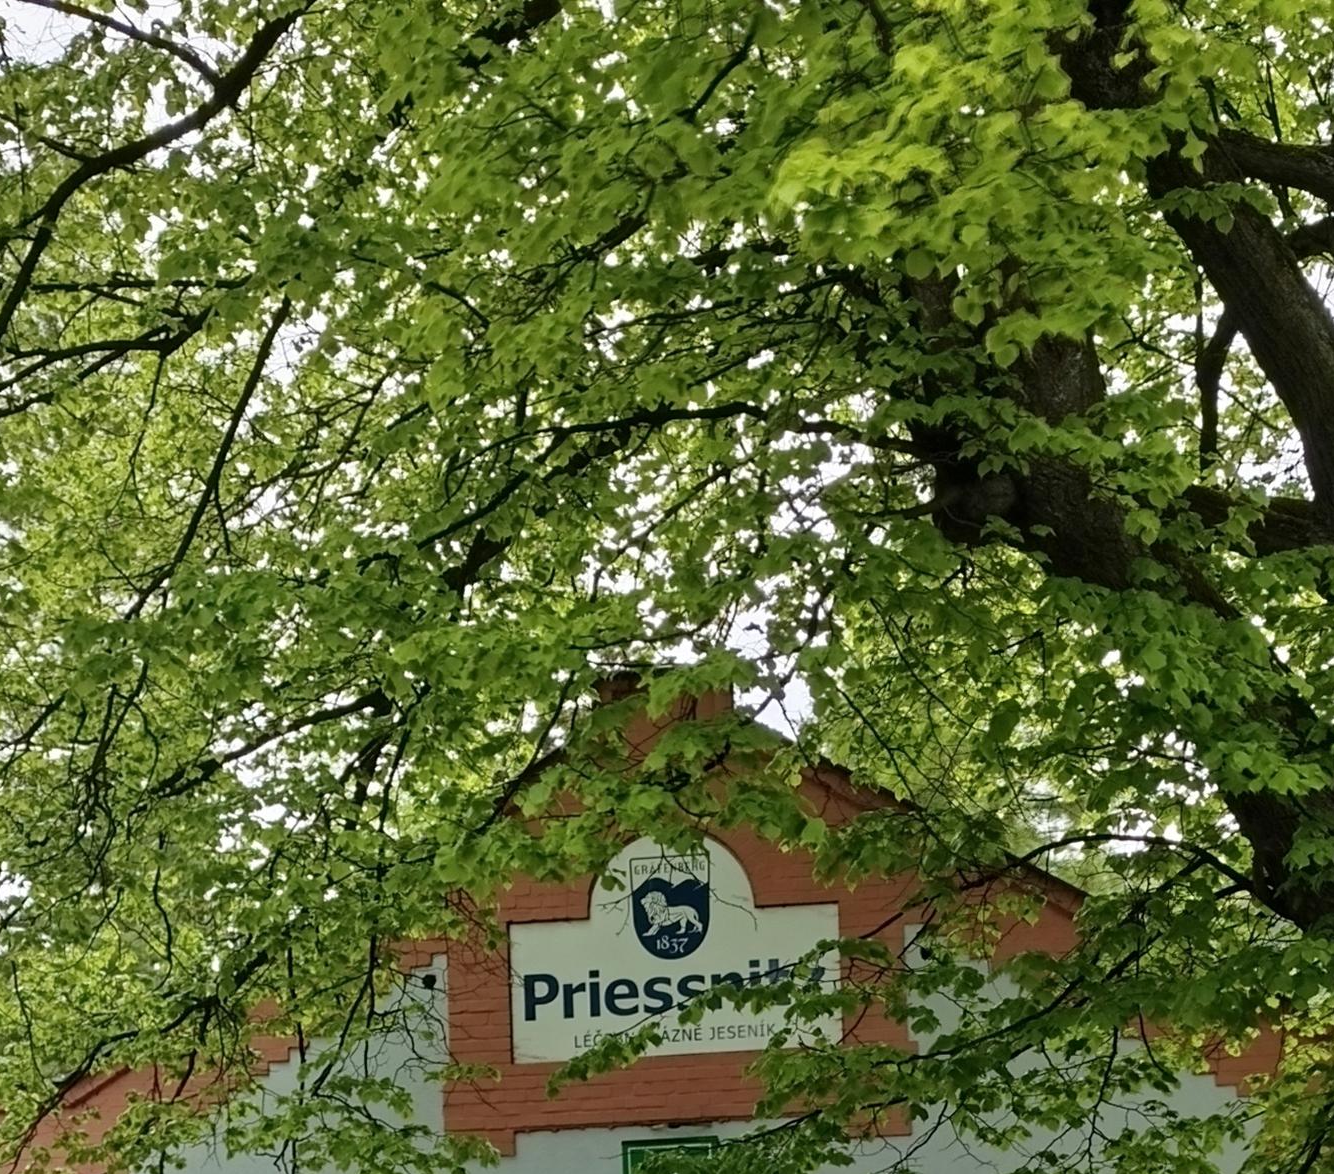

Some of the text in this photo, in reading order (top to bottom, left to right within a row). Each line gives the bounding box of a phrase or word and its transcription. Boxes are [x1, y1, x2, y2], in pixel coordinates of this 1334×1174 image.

[656, 935, 688, 954] 1837
[524, 958, 825, 1021] Priessnit
[710, 1021, 776, 1041] JESENÍK
